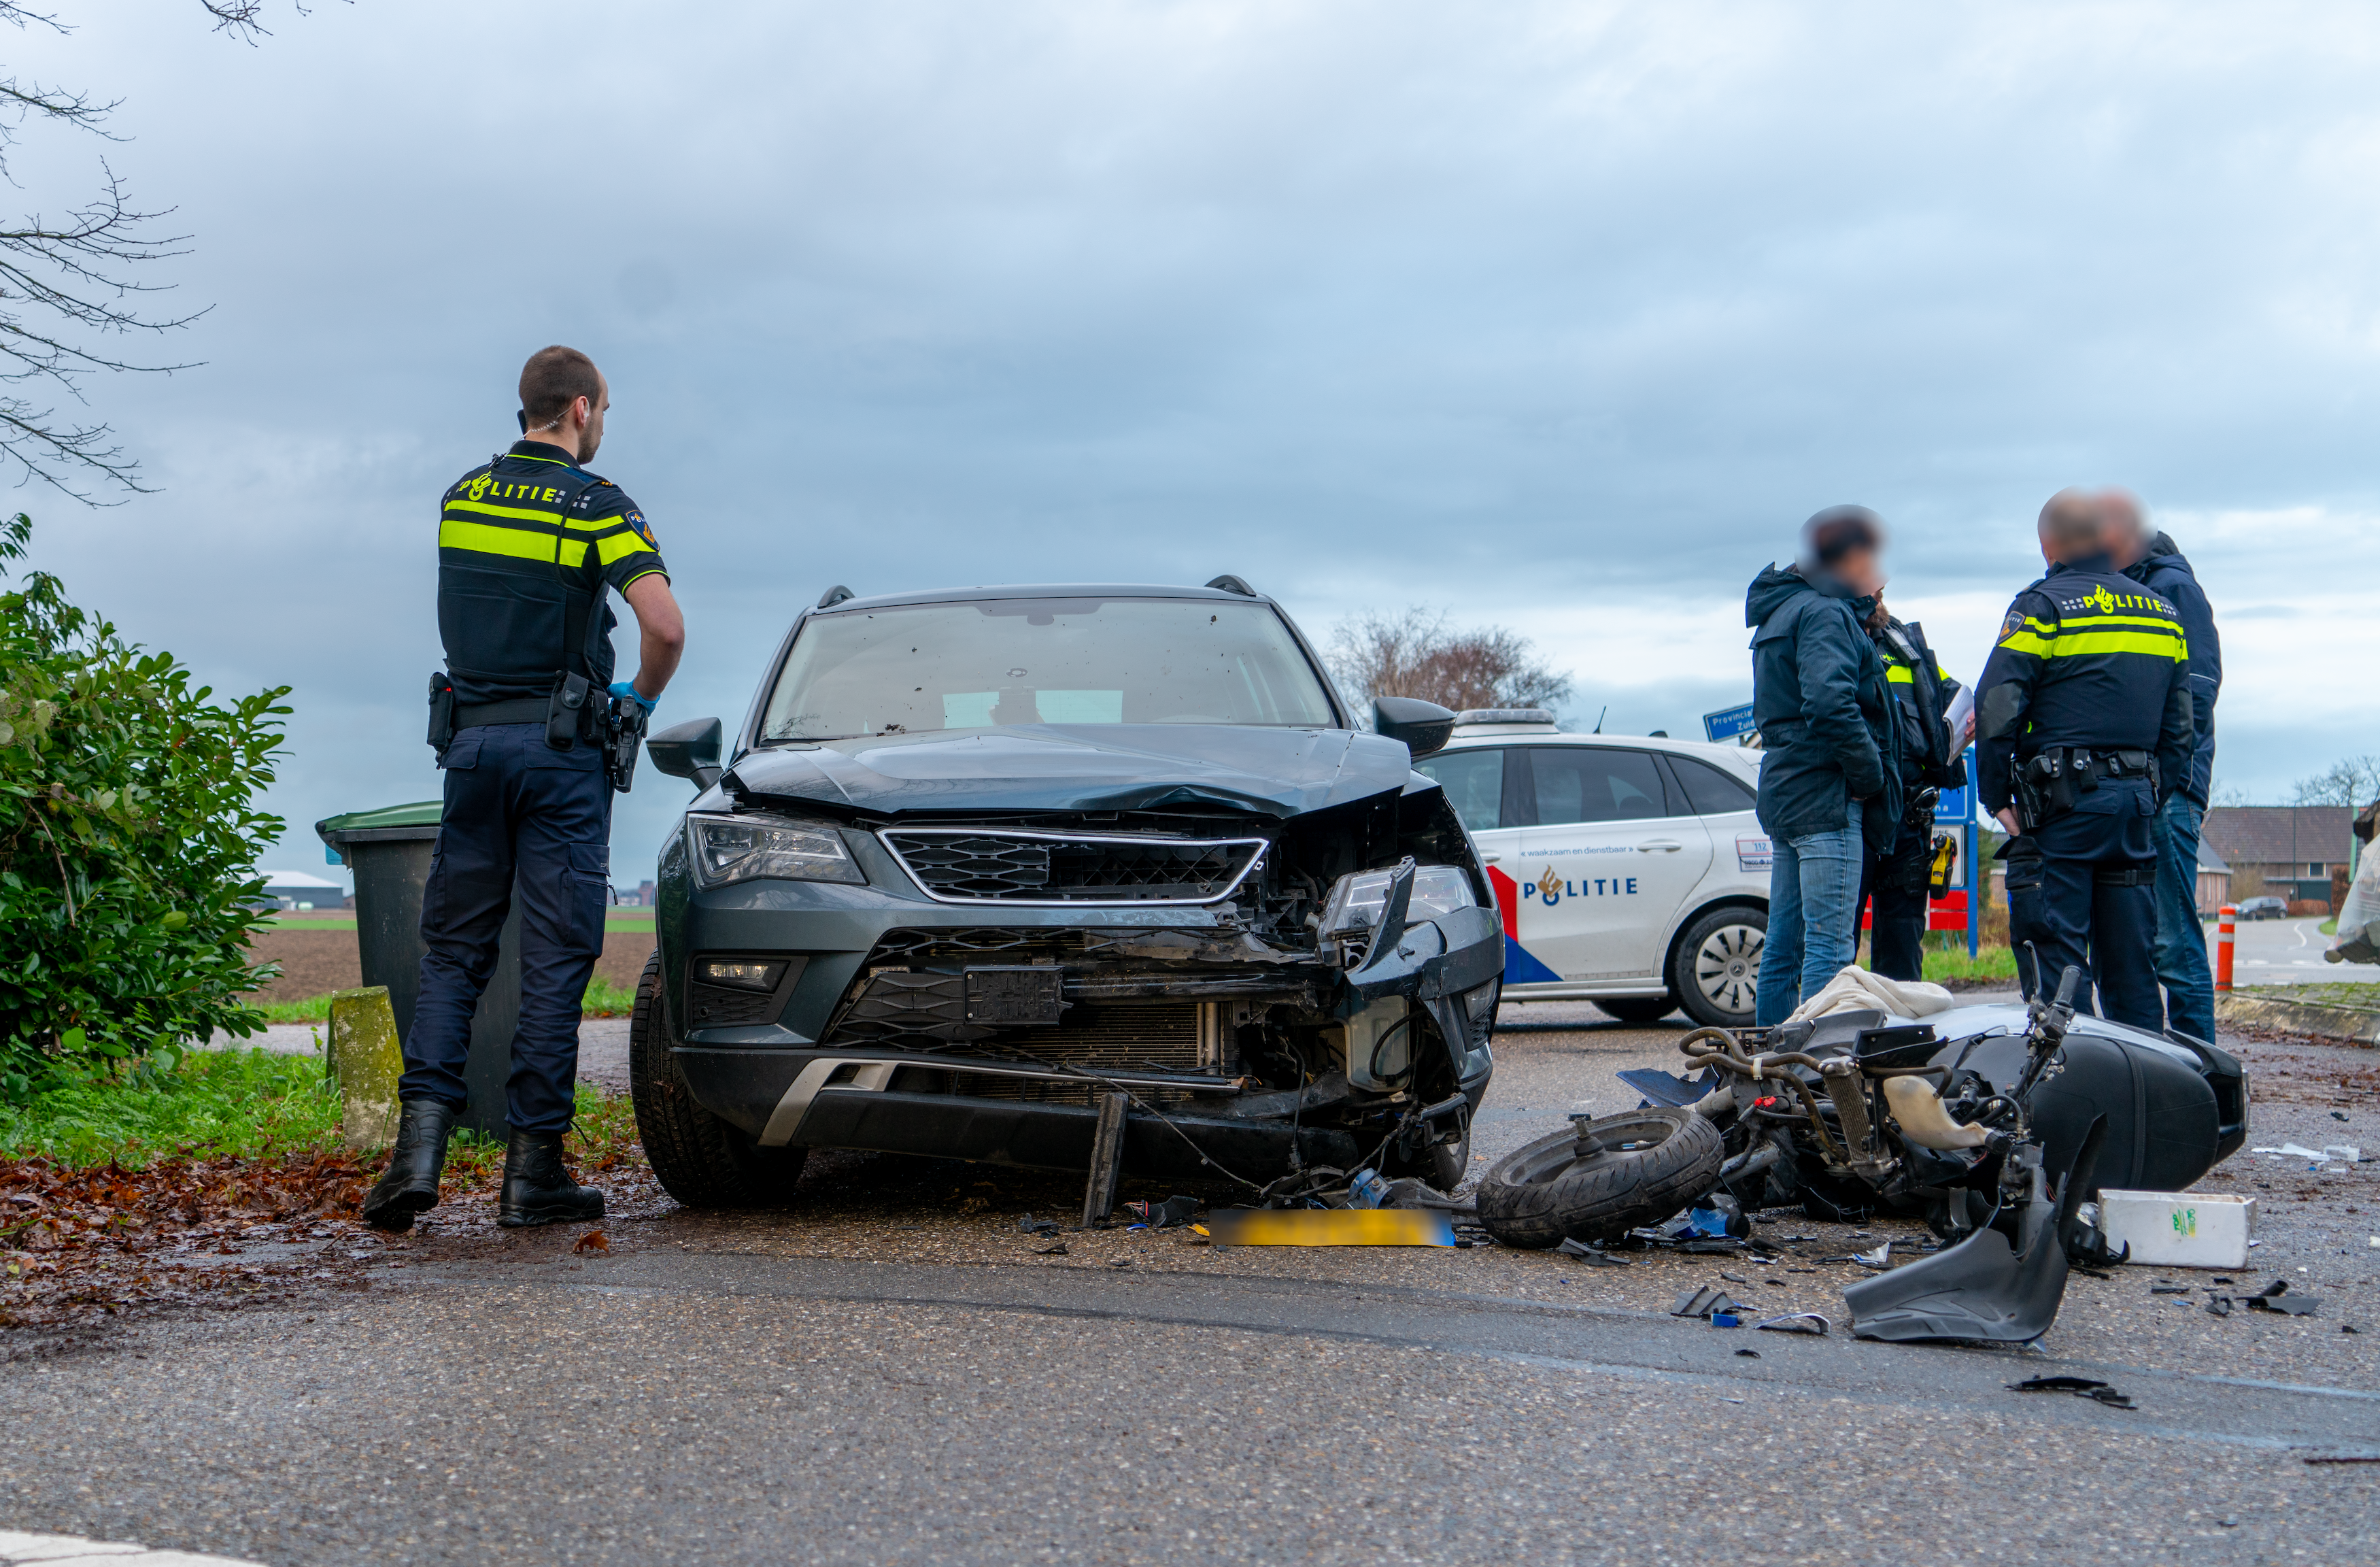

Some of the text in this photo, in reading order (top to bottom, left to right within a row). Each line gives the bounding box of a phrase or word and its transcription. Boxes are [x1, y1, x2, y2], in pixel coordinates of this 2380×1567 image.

[459, 471, 558, 501] POLITIE
[2082, 584, 2163, 614] POLITIE
[1528, 849, 1571, 857] waakzaam
[1584, 846, 1627, 854] dienstbaar
[1523, 864, 1637, 907] POLITIE
